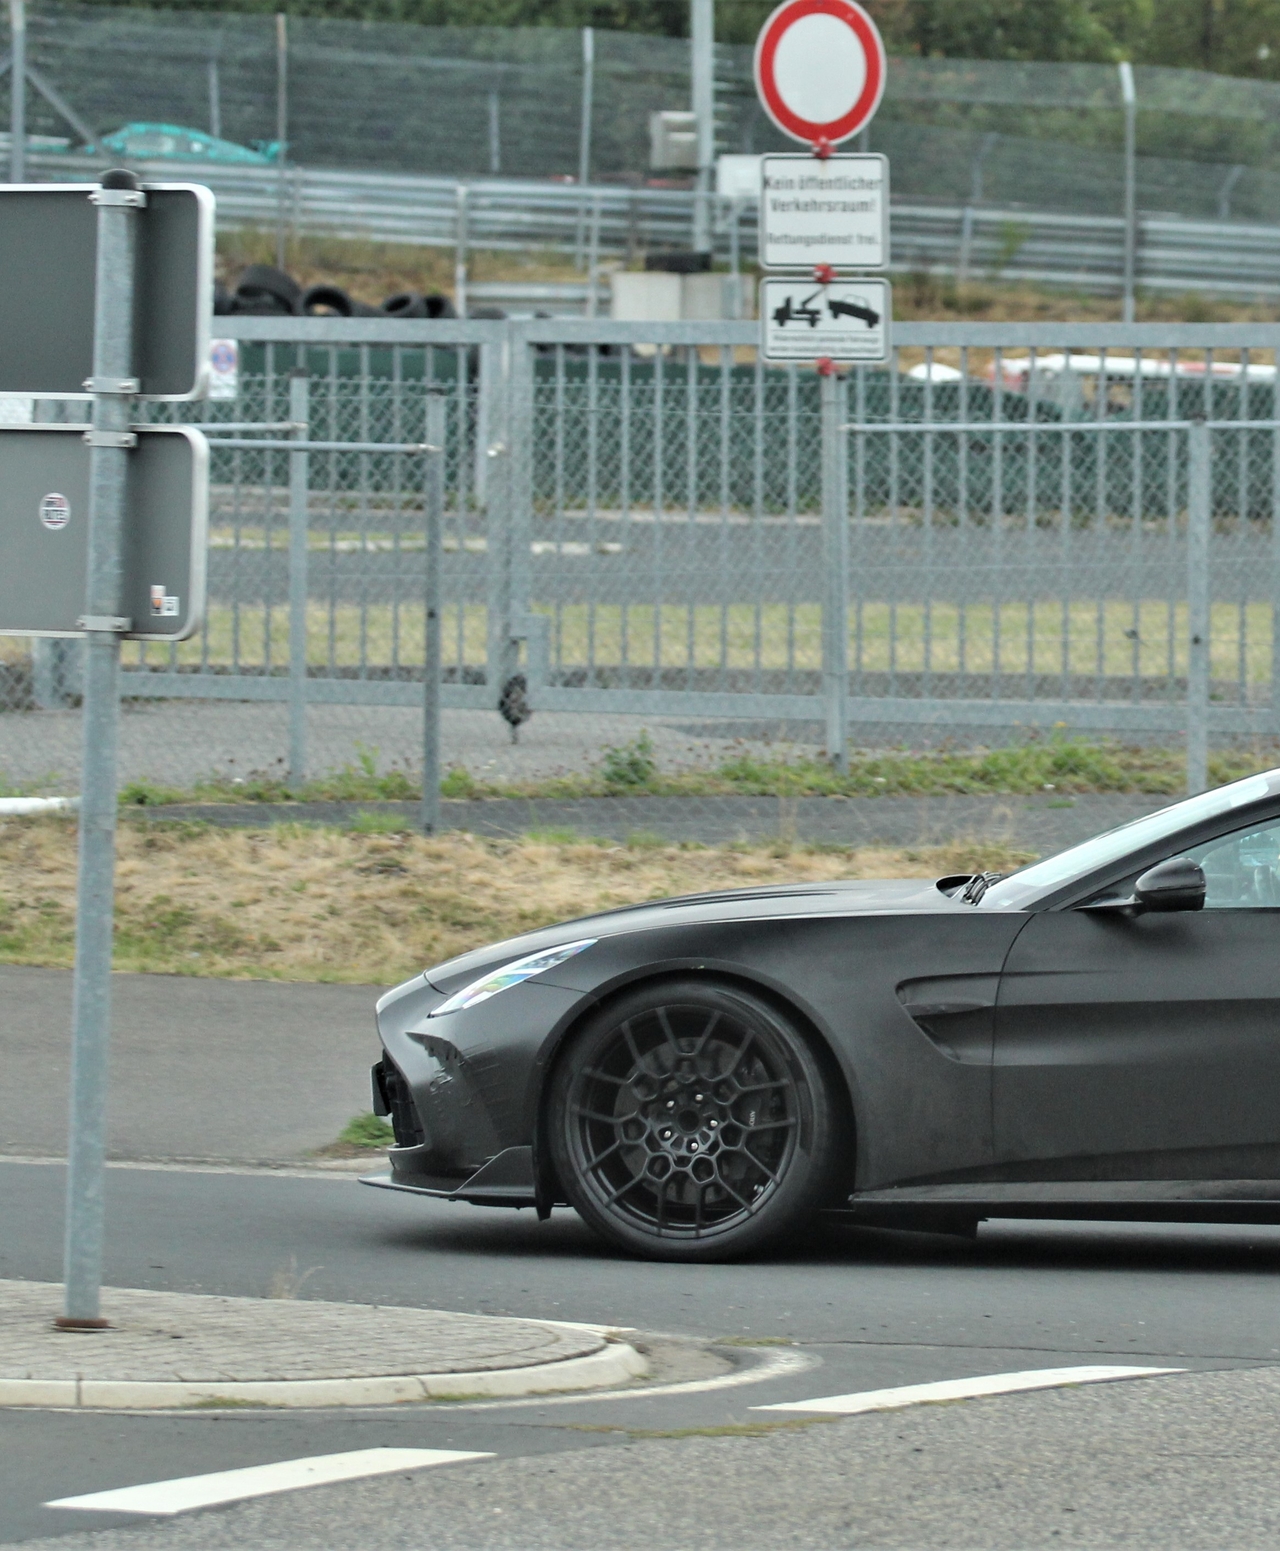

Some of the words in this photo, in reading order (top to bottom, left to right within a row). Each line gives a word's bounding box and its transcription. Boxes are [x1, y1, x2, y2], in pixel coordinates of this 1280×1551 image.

[763, 176, 794, 190] Kein
[798, 174, 882, 190] öffentlicher
[770, 198, 876, 212] Verkehrsraum!
[767, 233, 852, 247] Rettungsdienst
